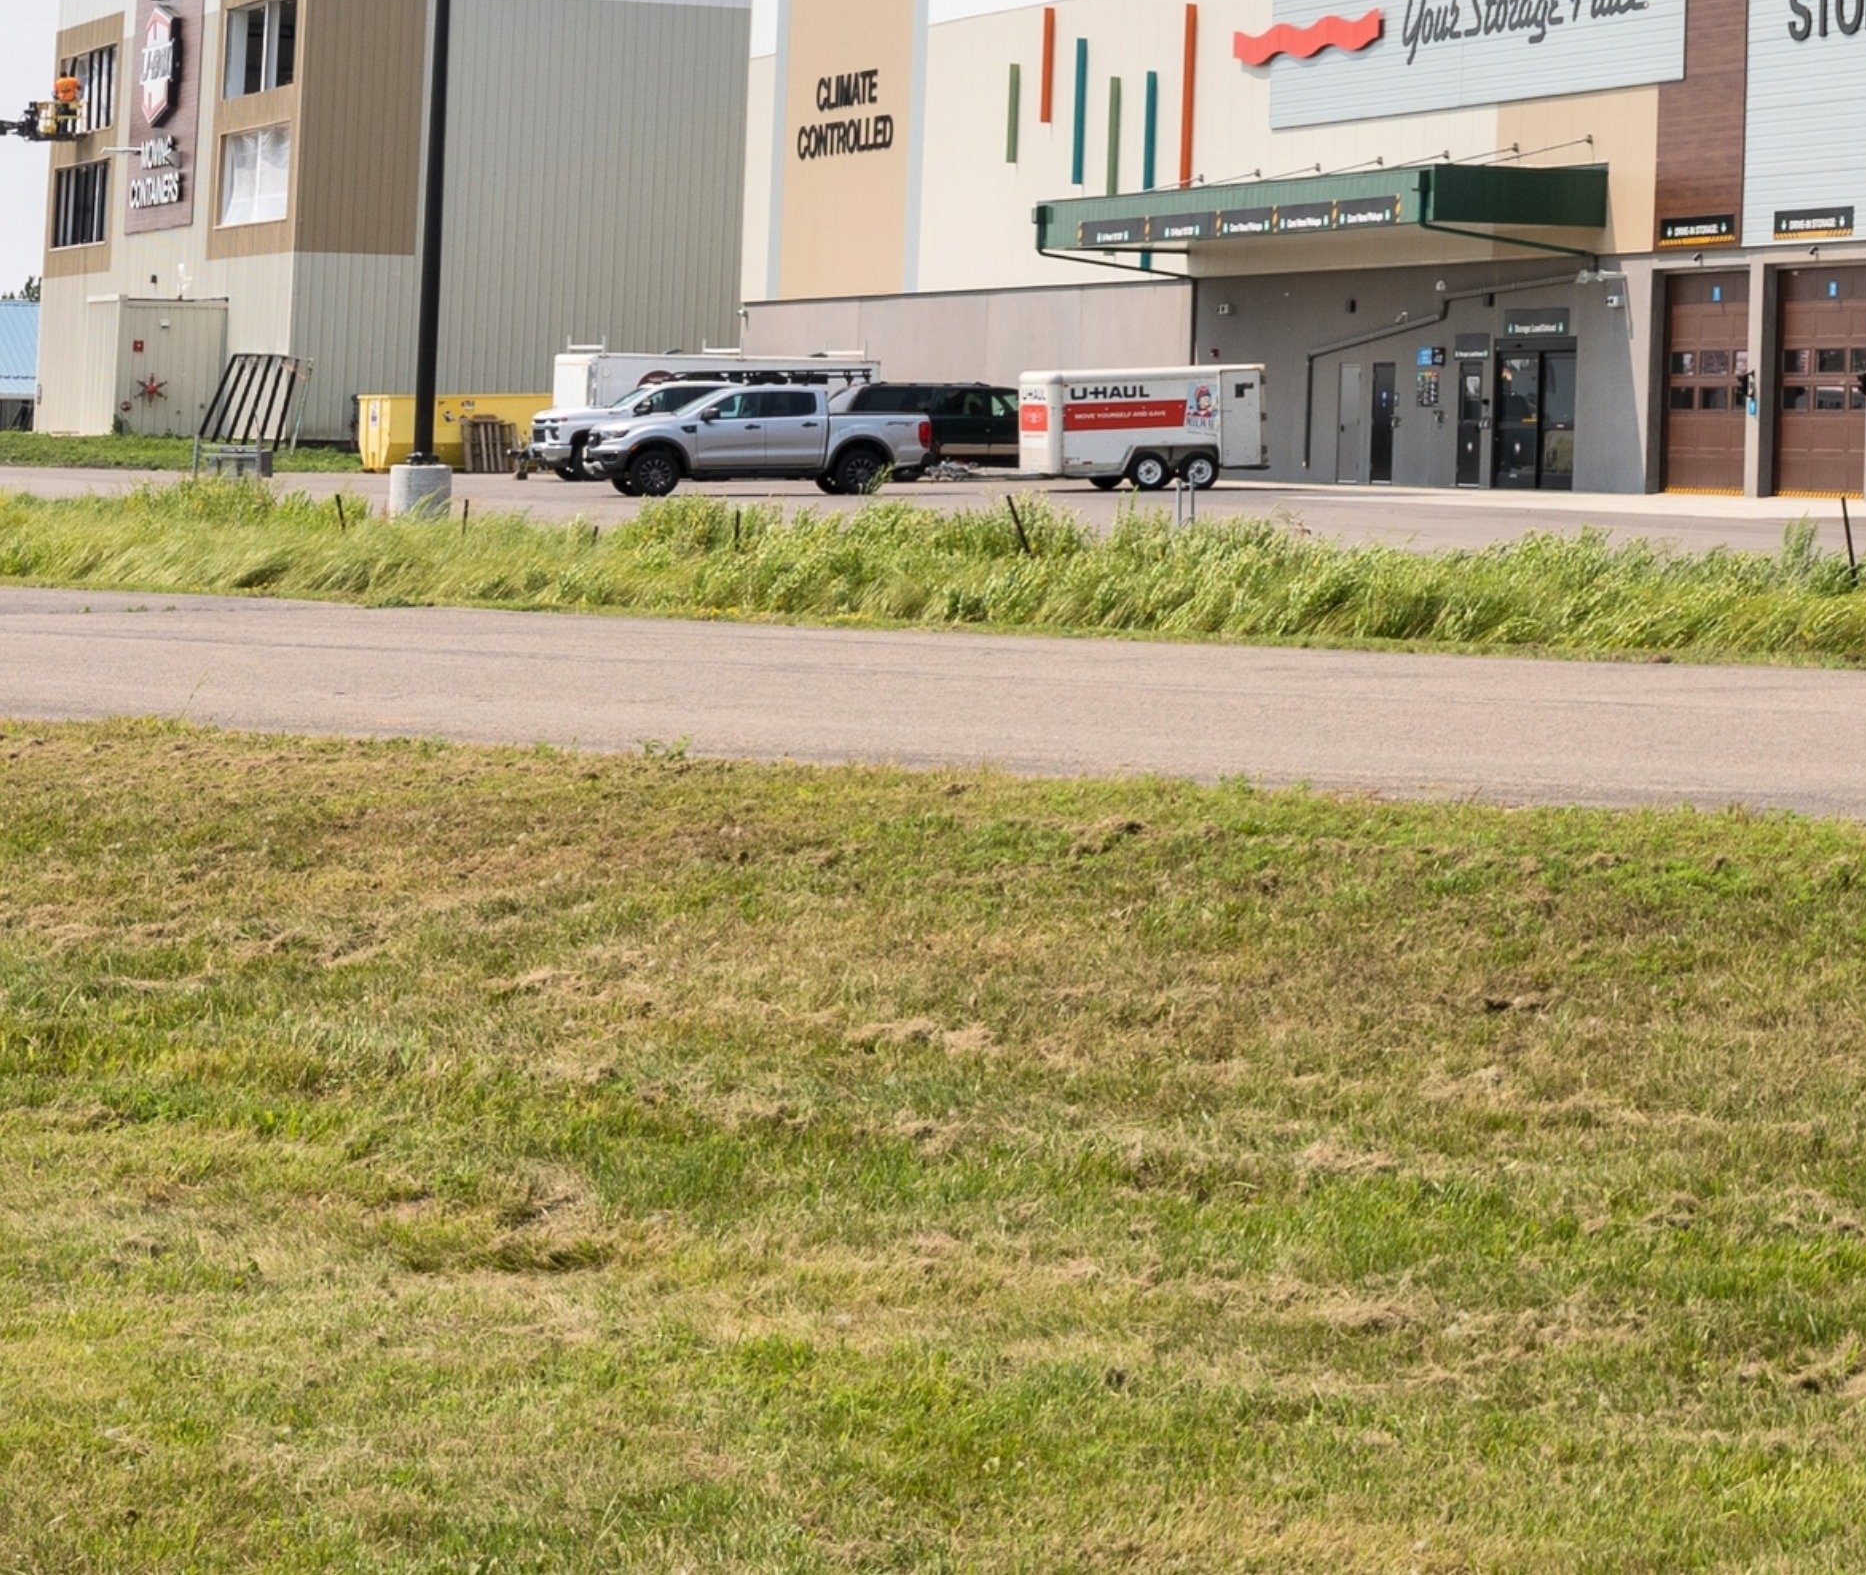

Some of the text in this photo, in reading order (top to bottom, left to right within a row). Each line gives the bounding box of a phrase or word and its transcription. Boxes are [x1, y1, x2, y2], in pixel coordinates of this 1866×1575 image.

[816, 69, 878, 112] CLIMATE
[797, 114, 894, 160] CONTROLLED
[129, 172, 180, 209] CONTAINERS
[1070, 385, 1150, 401] U-HAUL
[1097, 410, 1131, 419] YOURSELF
[1132, 410, 1147, 418] AND
[1148, 409, 1167, 417] SAVE
